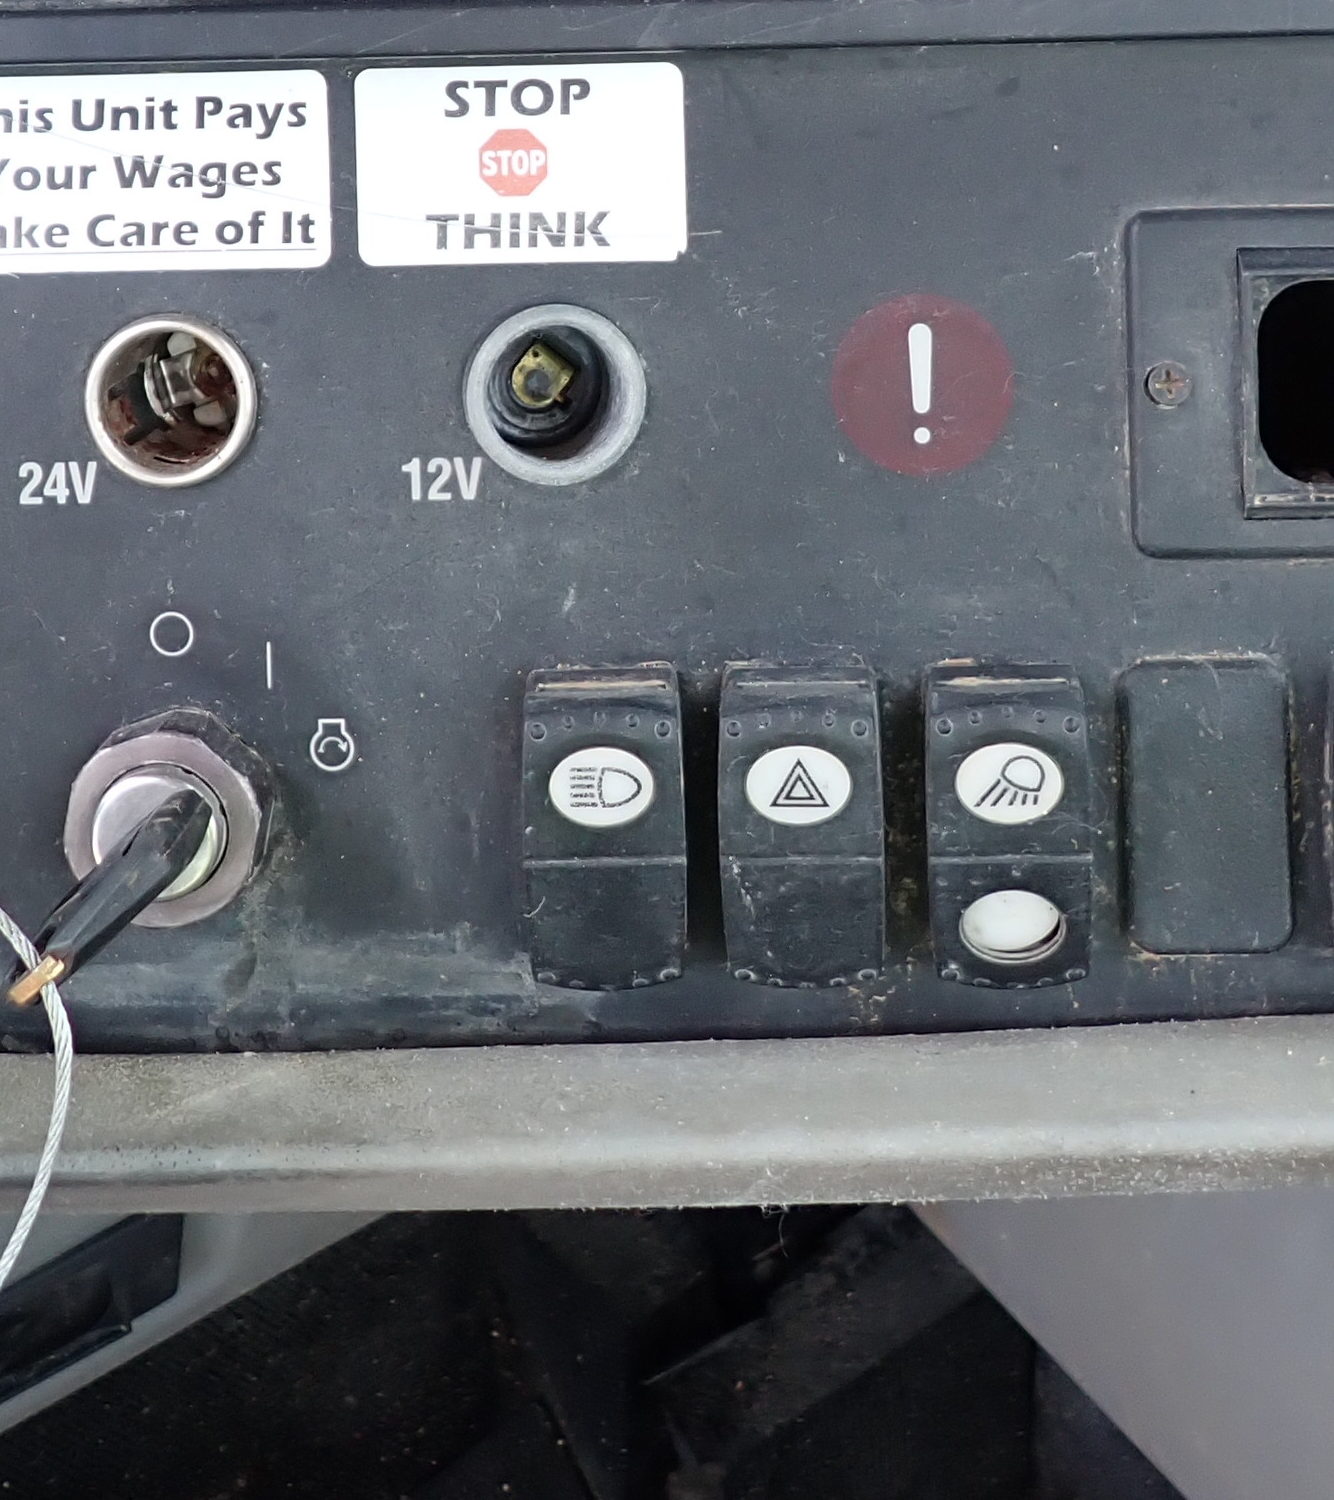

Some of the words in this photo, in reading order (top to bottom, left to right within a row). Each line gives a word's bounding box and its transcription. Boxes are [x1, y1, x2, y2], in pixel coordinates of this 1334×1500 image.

[71, 98, 178, 132] Unit
[195, 96, 308, 138] Pays
[444, 78, 591, 117] STOP
[113, 153, 283, 198] Wages
[482, 148, 546, 178] STOP
[85, 214, 198, 248] Care
[214, 211, 266, 245] of
[280, 211, 316, 244] It
[426, 211, 611, 250] THINK
[19, 462, 97, 505] 24V
[402, 457, 483, 501] 12V
